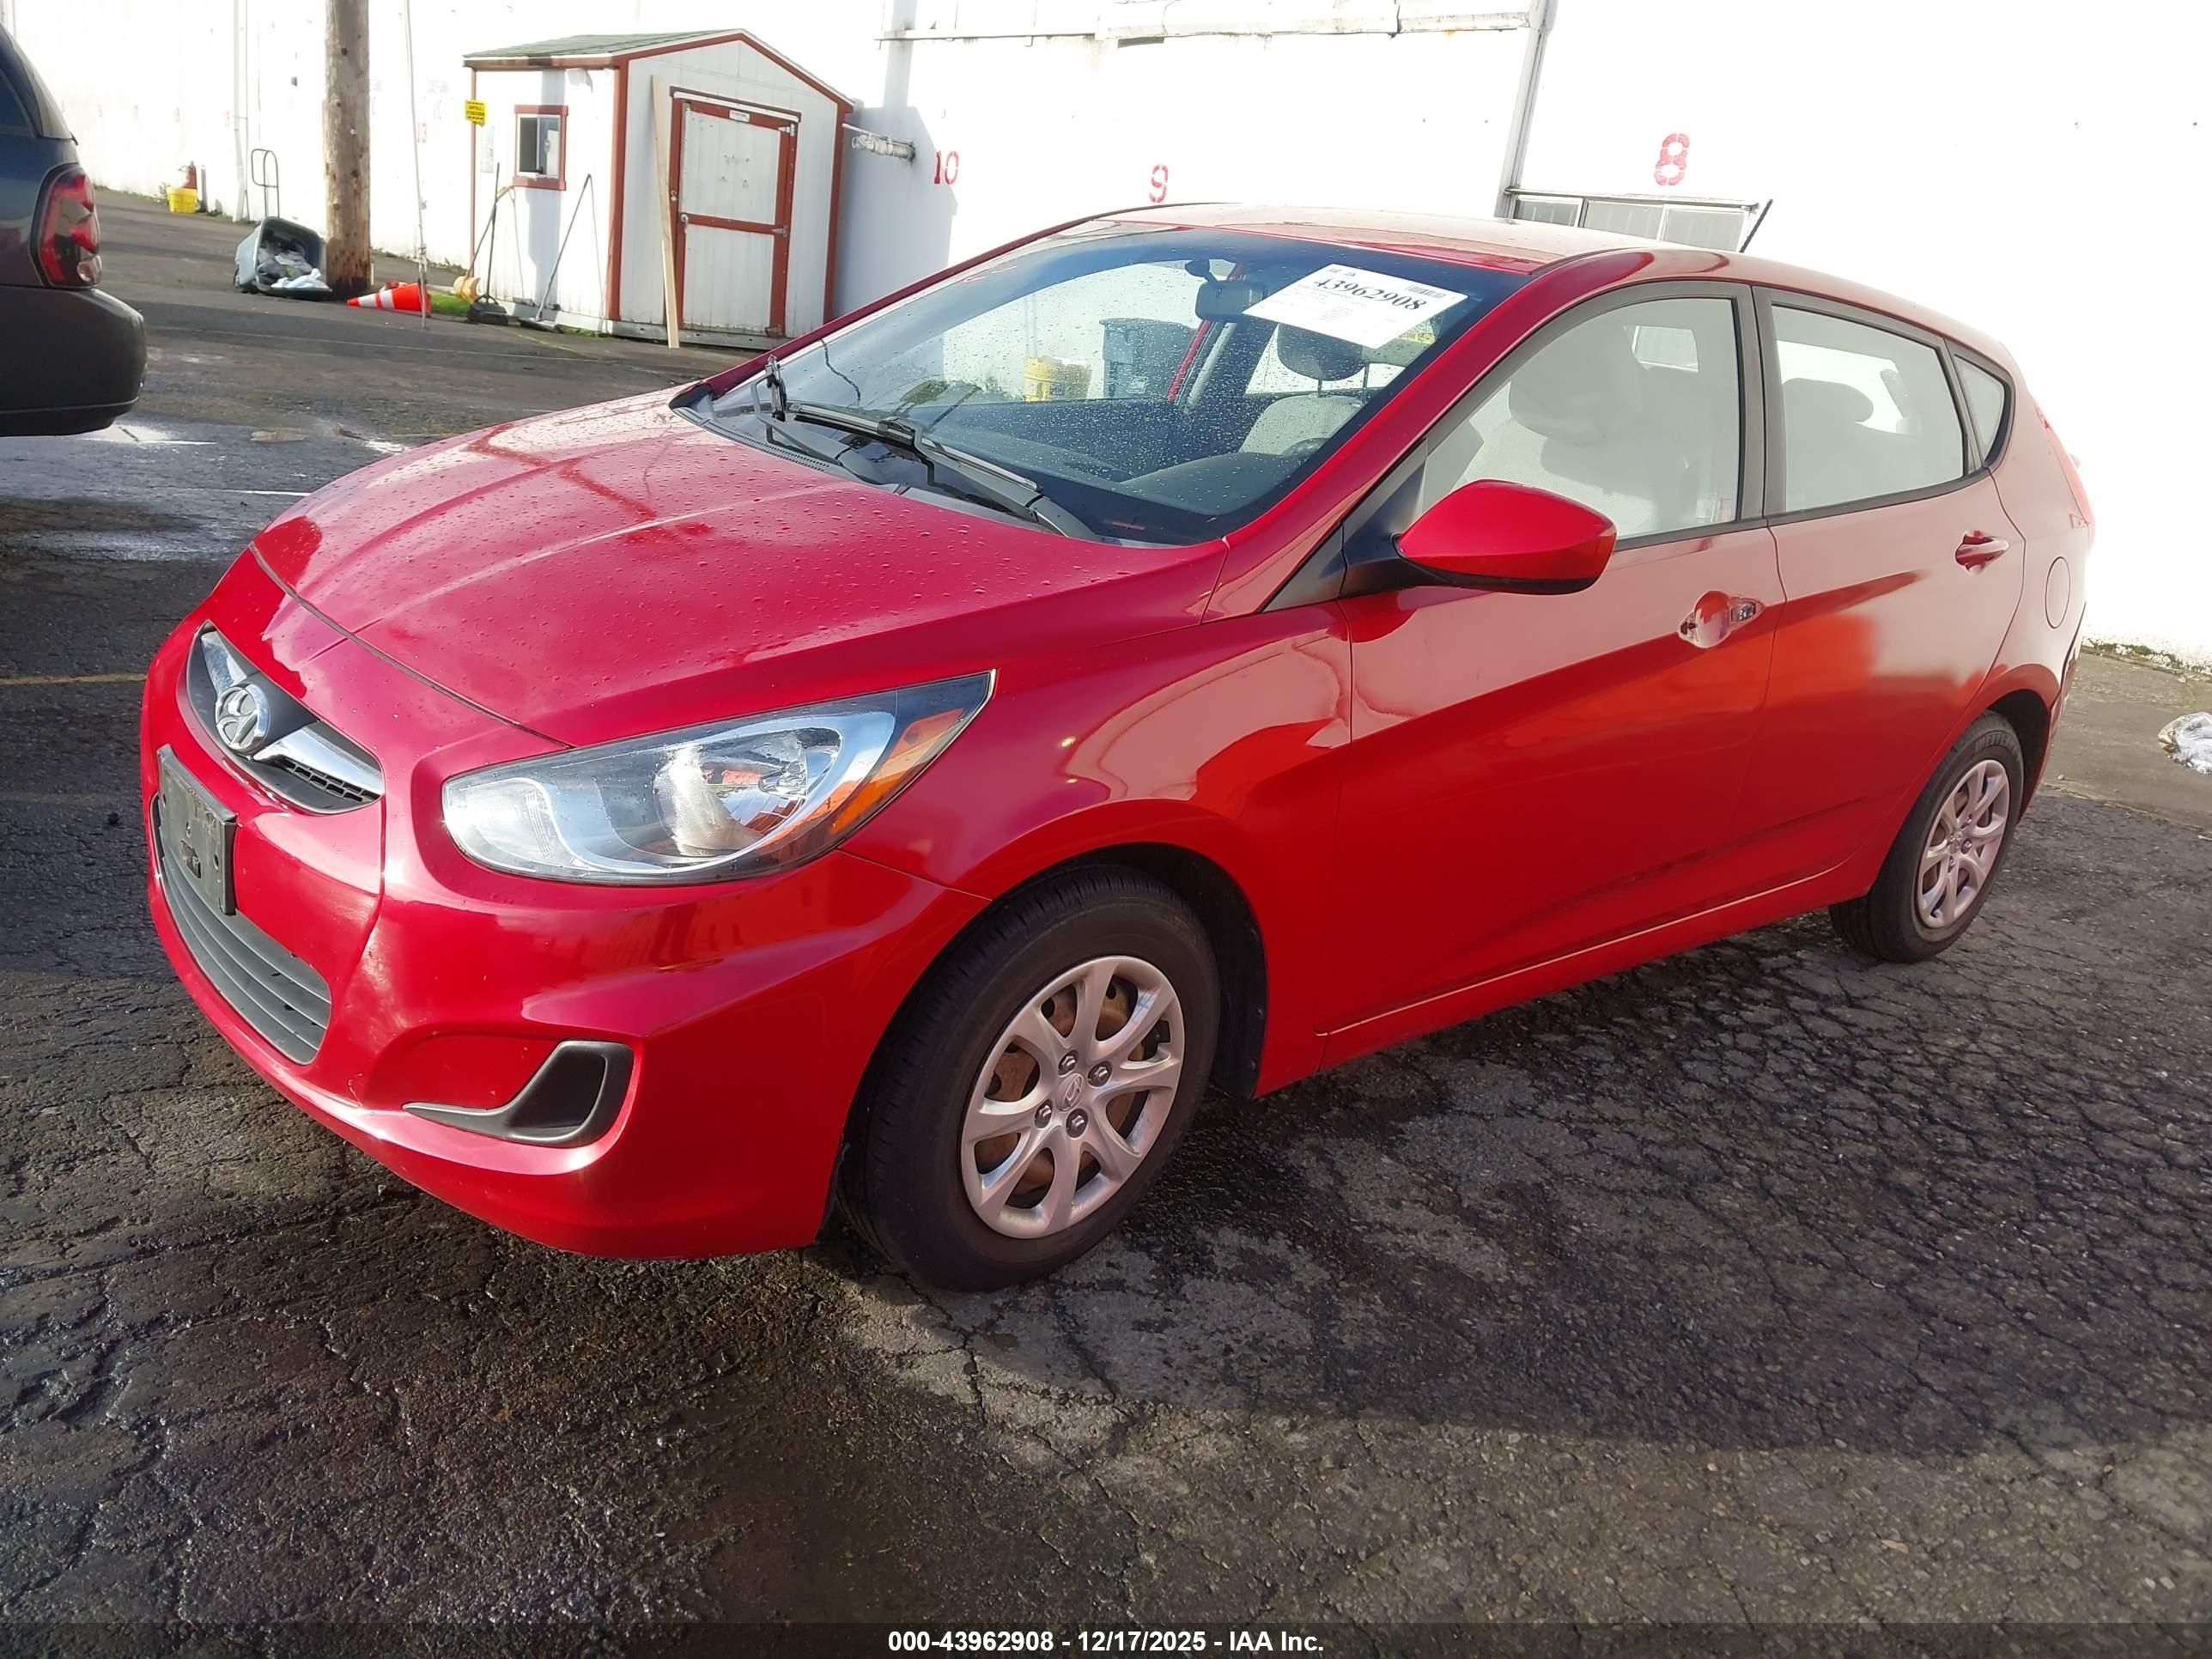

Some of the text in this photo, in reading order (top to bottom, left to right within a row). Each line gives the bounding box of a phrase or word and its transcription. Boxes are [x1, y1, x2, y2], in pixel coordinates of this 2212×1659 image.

[934, 150, 959, 185] 10
[1656, 133, 1690, 185] 8
[1149, 165, 1169, 204] 9
[1314, 277, 1427, 310] 43962908
